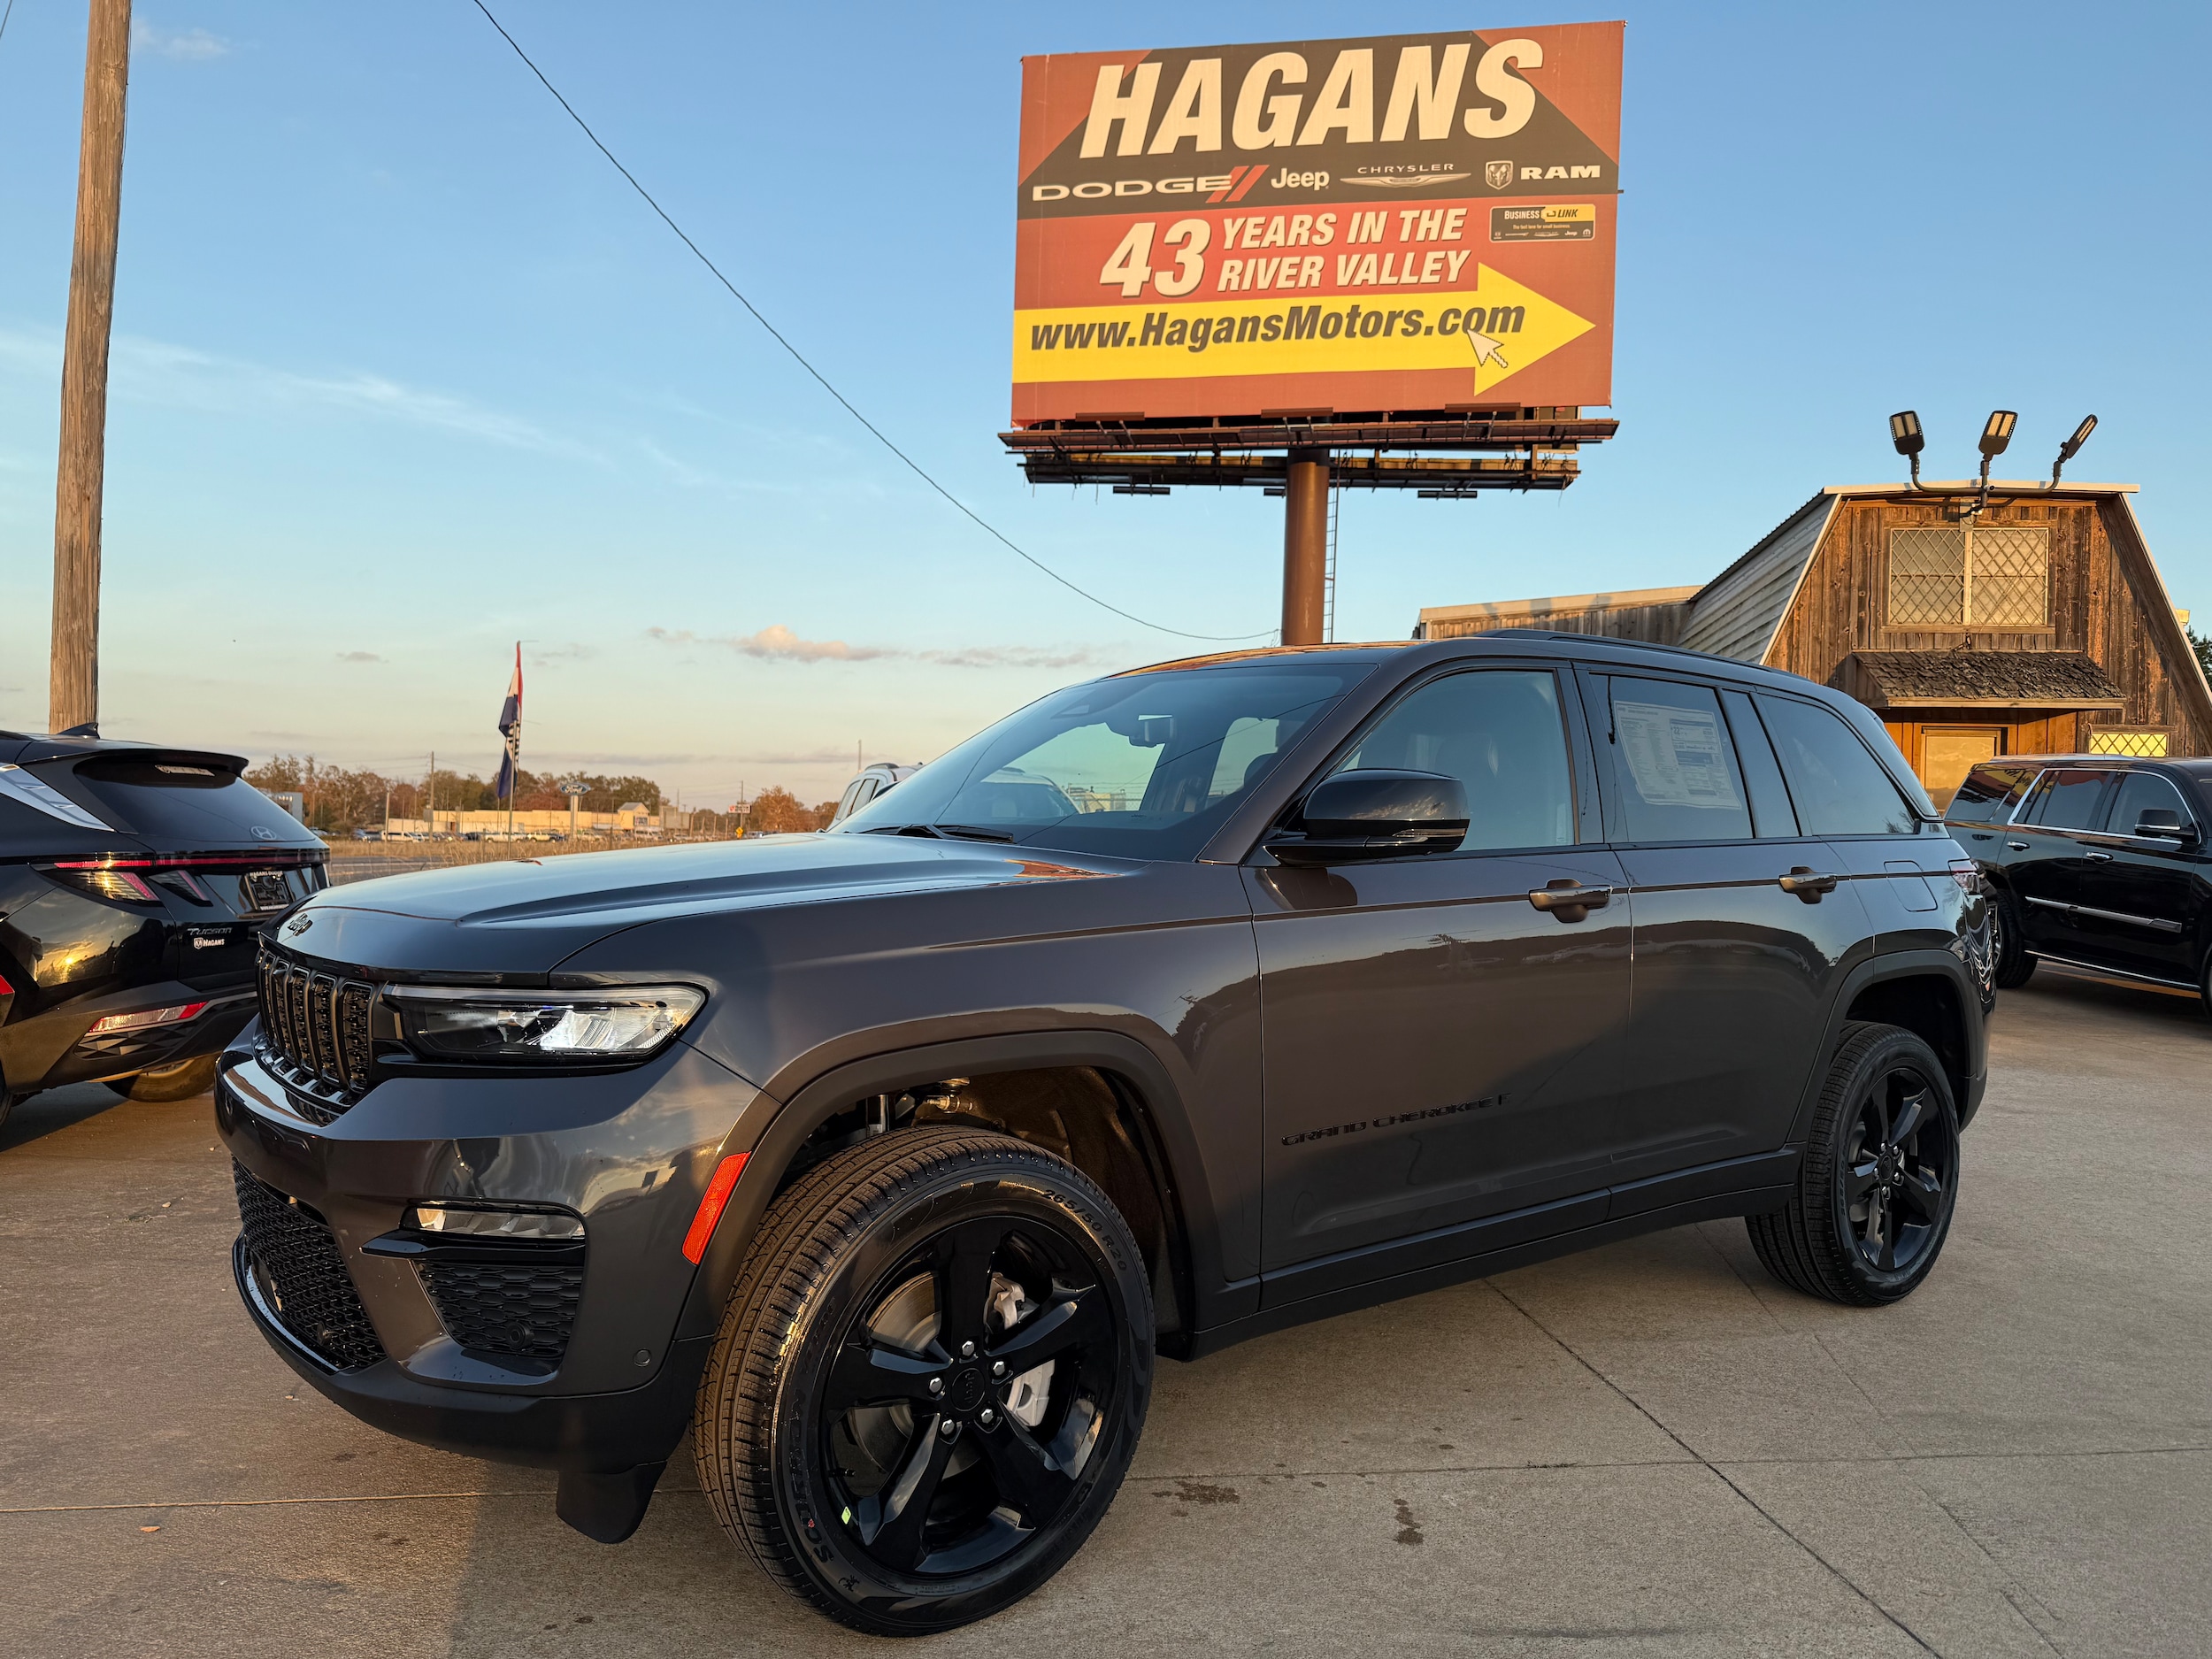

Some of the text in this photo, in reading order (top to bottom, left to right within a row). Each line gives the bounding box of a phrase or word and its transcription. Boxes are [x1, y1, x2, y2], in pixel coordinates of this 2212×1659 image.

[1079, 38, 1544, 158] HAGANS
[1033, 174, 1232, 201] DODGE
[1271, 168, 1329, 190] Jeep
[1357, 164, 1454, 173] CHRYSLER
[1521, 165, 1601, 180] RAM
[1223, 208, 1468, 250] YEARS IN THE
[1504, 209, 1578, 219] BUSINESS LINK
[1099, 219, 1212, 298] 43
[1217, 250, 1471, 292] RIVER VALLEY
[1031, 304, 1525, 353] www.HagansMotors.com
[1281, 1096, 1494, 1146] GRAND CHEROKEE
